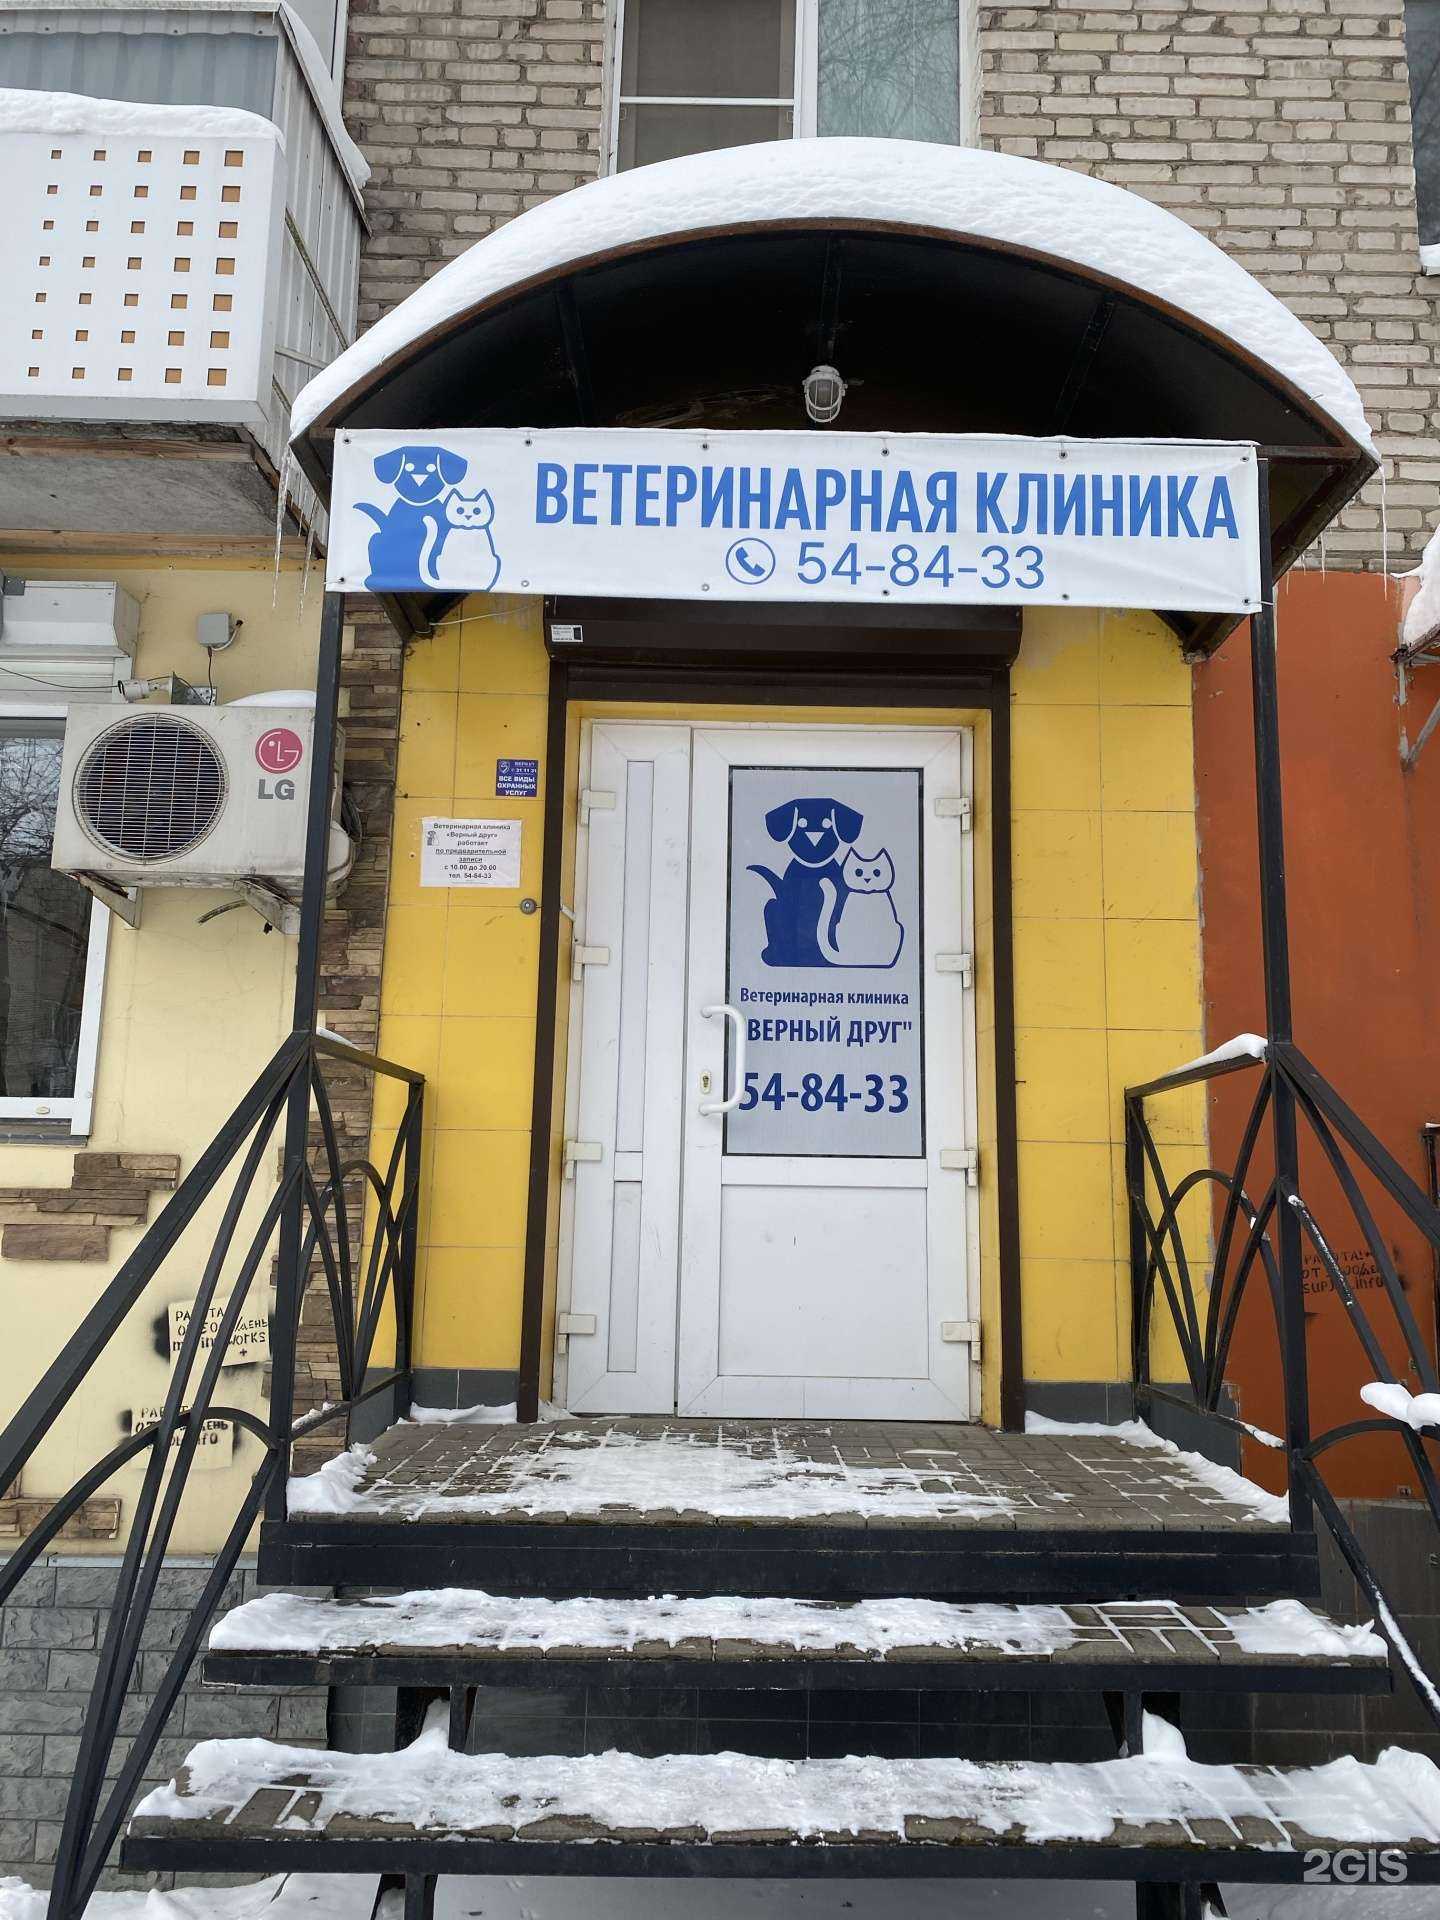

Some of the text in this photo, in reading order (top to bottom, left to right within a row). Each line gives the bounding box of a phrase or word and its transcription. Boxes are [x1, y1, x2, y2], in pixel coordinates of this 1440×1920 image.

[536, 462, 1239, 539] ВЕТЕРИНАРНАЯ КЛИНИКА
[798, 541, 1045, 590] 54-84-33
[258, 778, 295, 801] LG
[740, 987, 909, 1007] Ветеринарная клиника
[847, 1020, 912, 1048] ДРУГ"
[738, 1072, 909, 1114] 54-84-33
